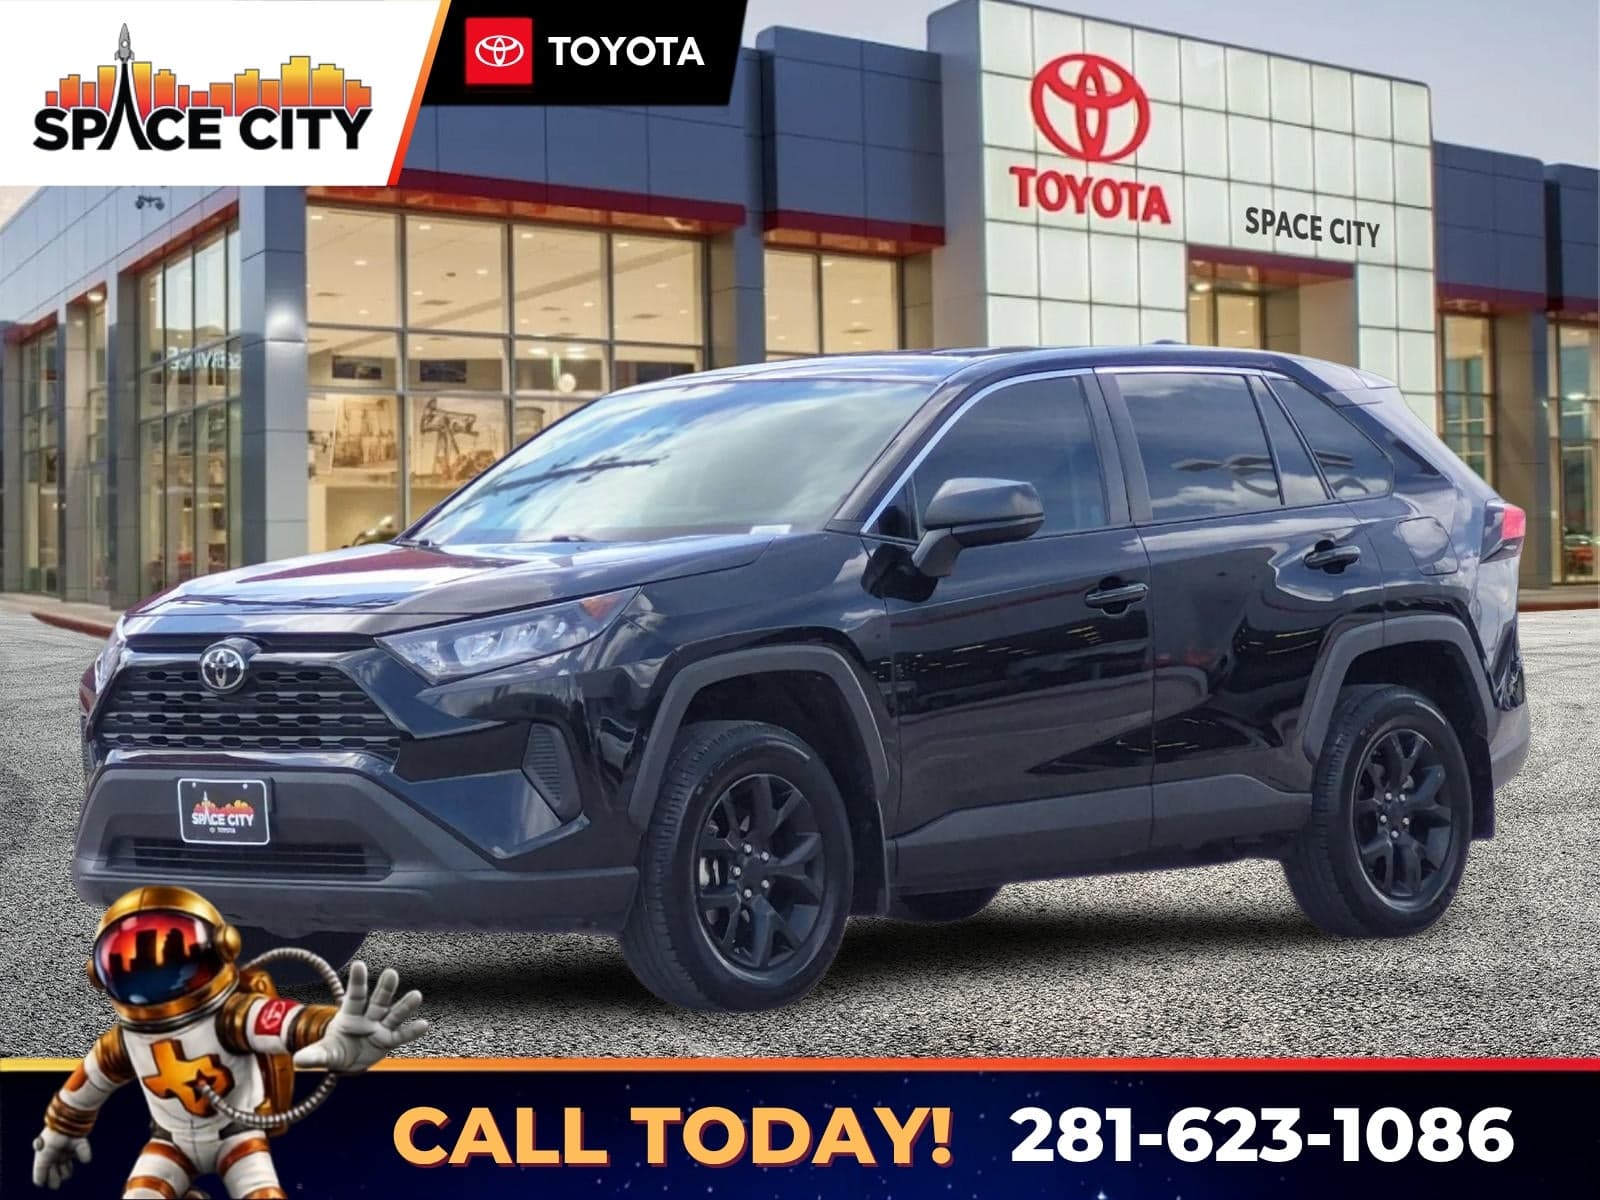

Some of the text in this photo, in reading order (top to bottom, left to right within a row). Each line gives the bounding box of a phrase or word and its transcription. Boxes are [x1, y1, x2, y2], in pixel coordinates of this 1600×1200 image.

[1009, 166, 1171, 224] TOYOTA
[1245, 207, 1380, 248] SPACE CITY
[192, 812, 254, 827] SPACE CITY
